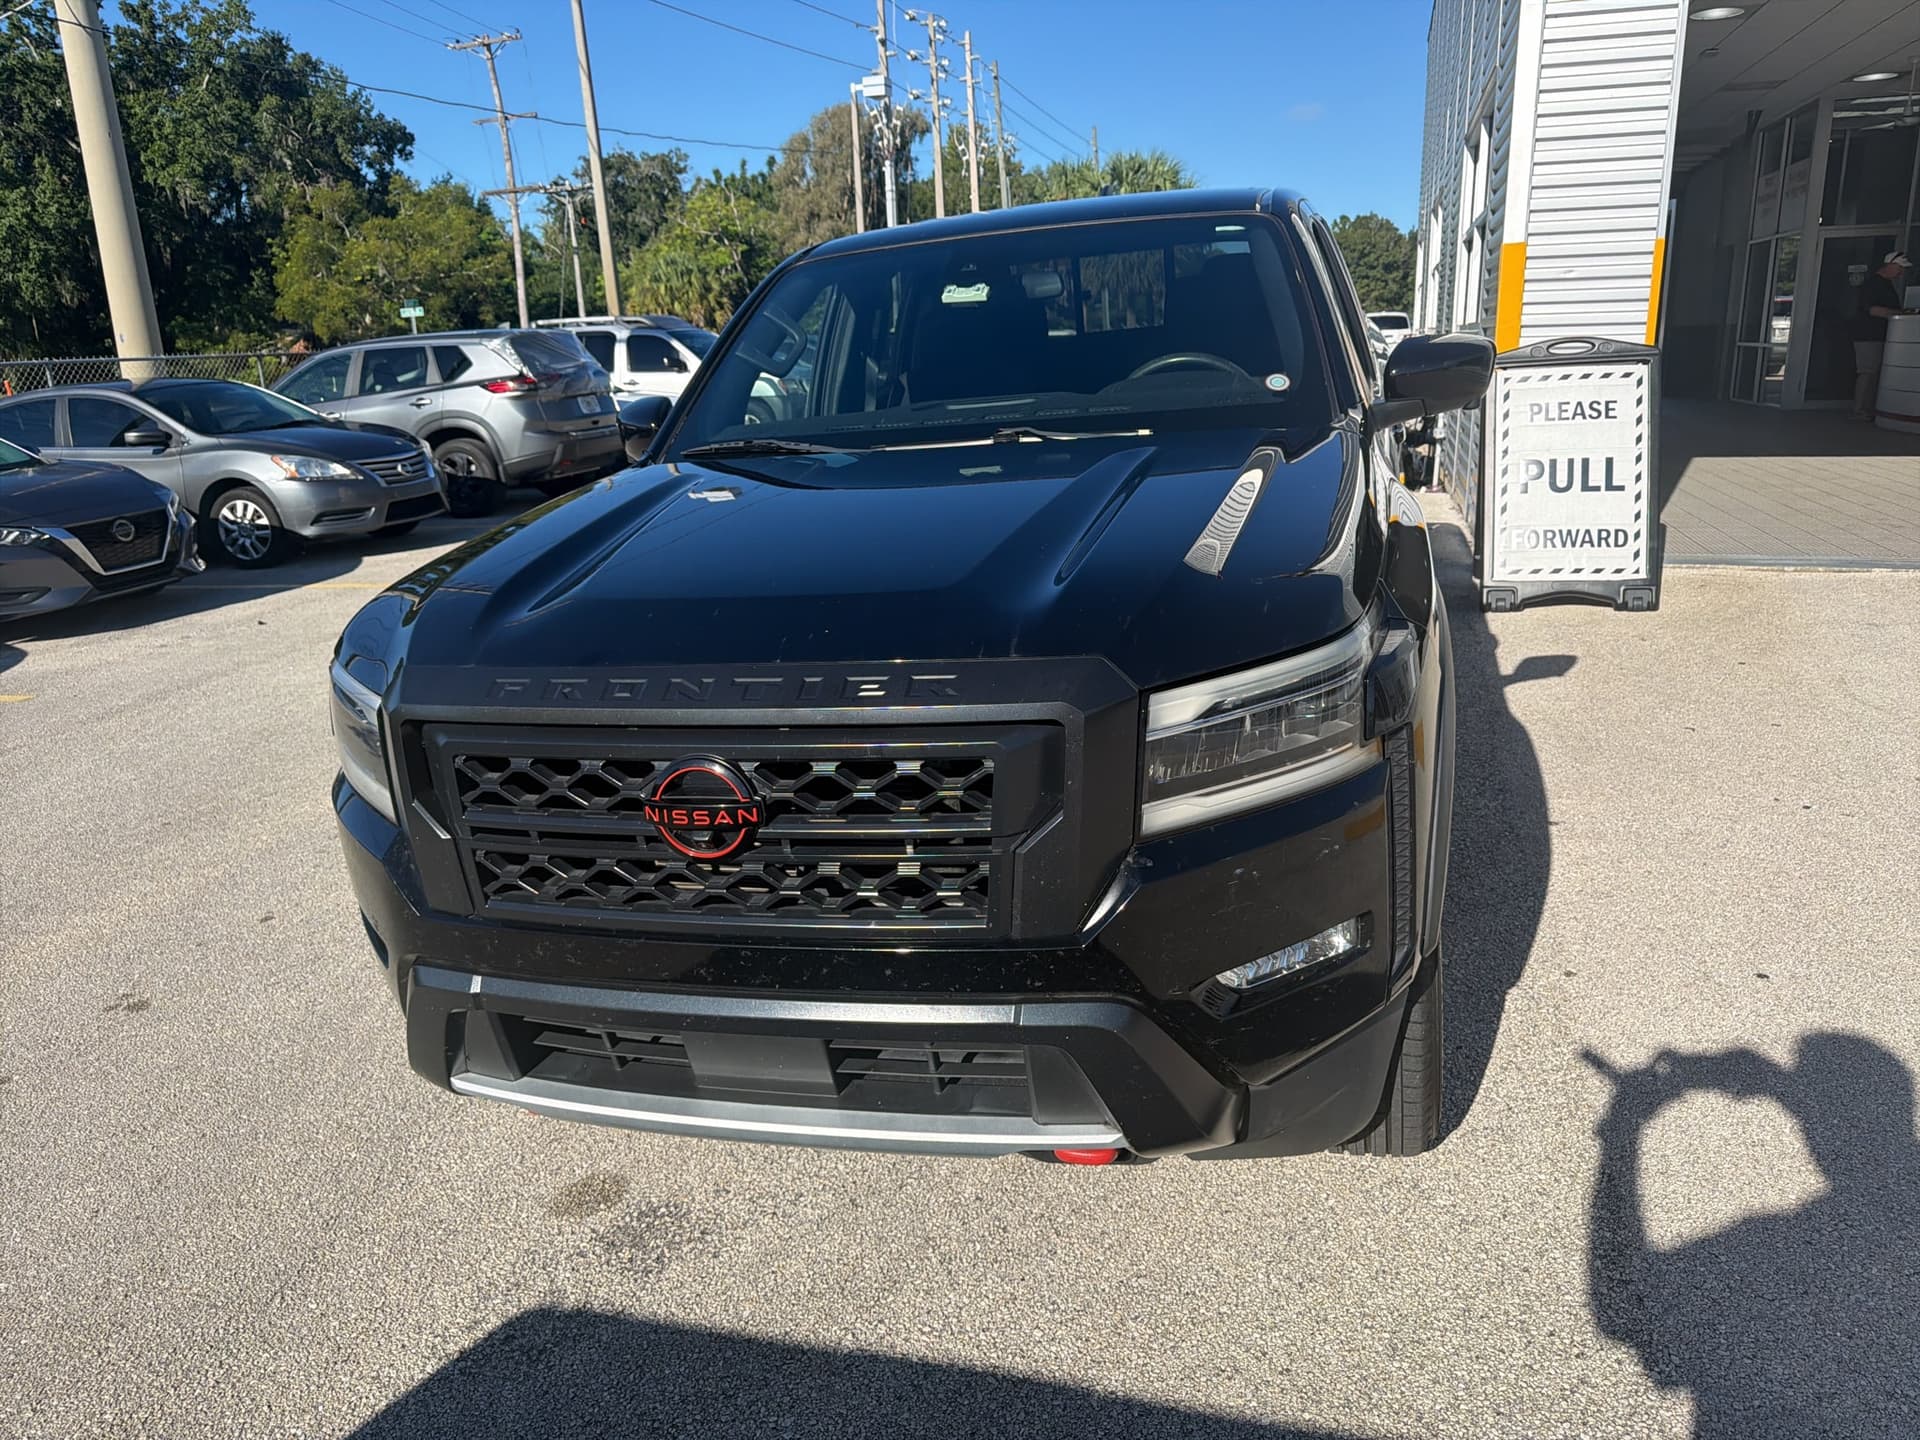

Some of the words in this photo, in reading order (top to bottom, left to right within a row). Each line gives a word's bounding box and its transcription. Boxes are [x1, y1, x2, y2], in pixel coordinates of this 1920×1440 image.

[1528, 400, 1618, 422] PLEASE
[1520, 457, 1626, 494] PULL
[486, 675, 959, 701] FRONTIER
[644, 806, 758, 825] NISSAN
